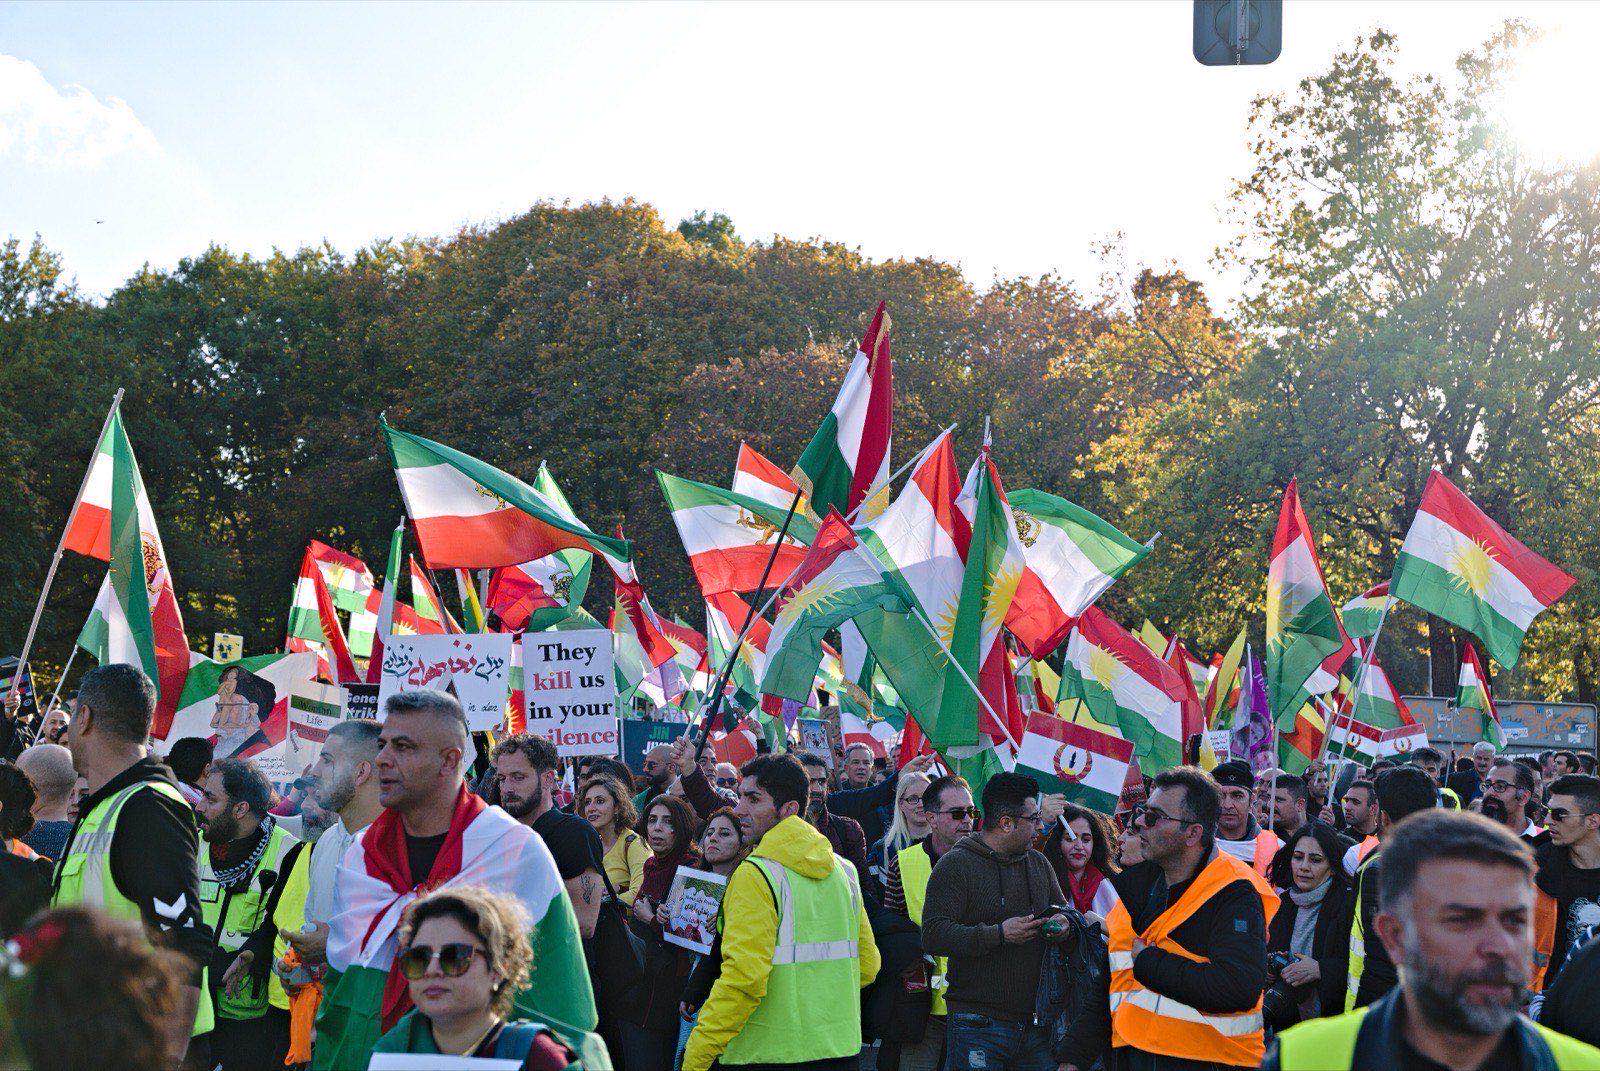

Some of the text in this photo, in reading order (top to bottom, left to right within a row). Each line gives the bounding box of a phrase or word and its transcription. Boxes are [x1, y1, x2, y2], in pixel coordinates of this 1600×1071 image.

[538, 643, 597, 666] They
[533, 670, 605, 691] kill us
[347, 692, 378, 704] Gene
[306, 714, 323, 726] Life
[529, 701, 613, 724] in your
[541, 728, 615, 746] ilence
